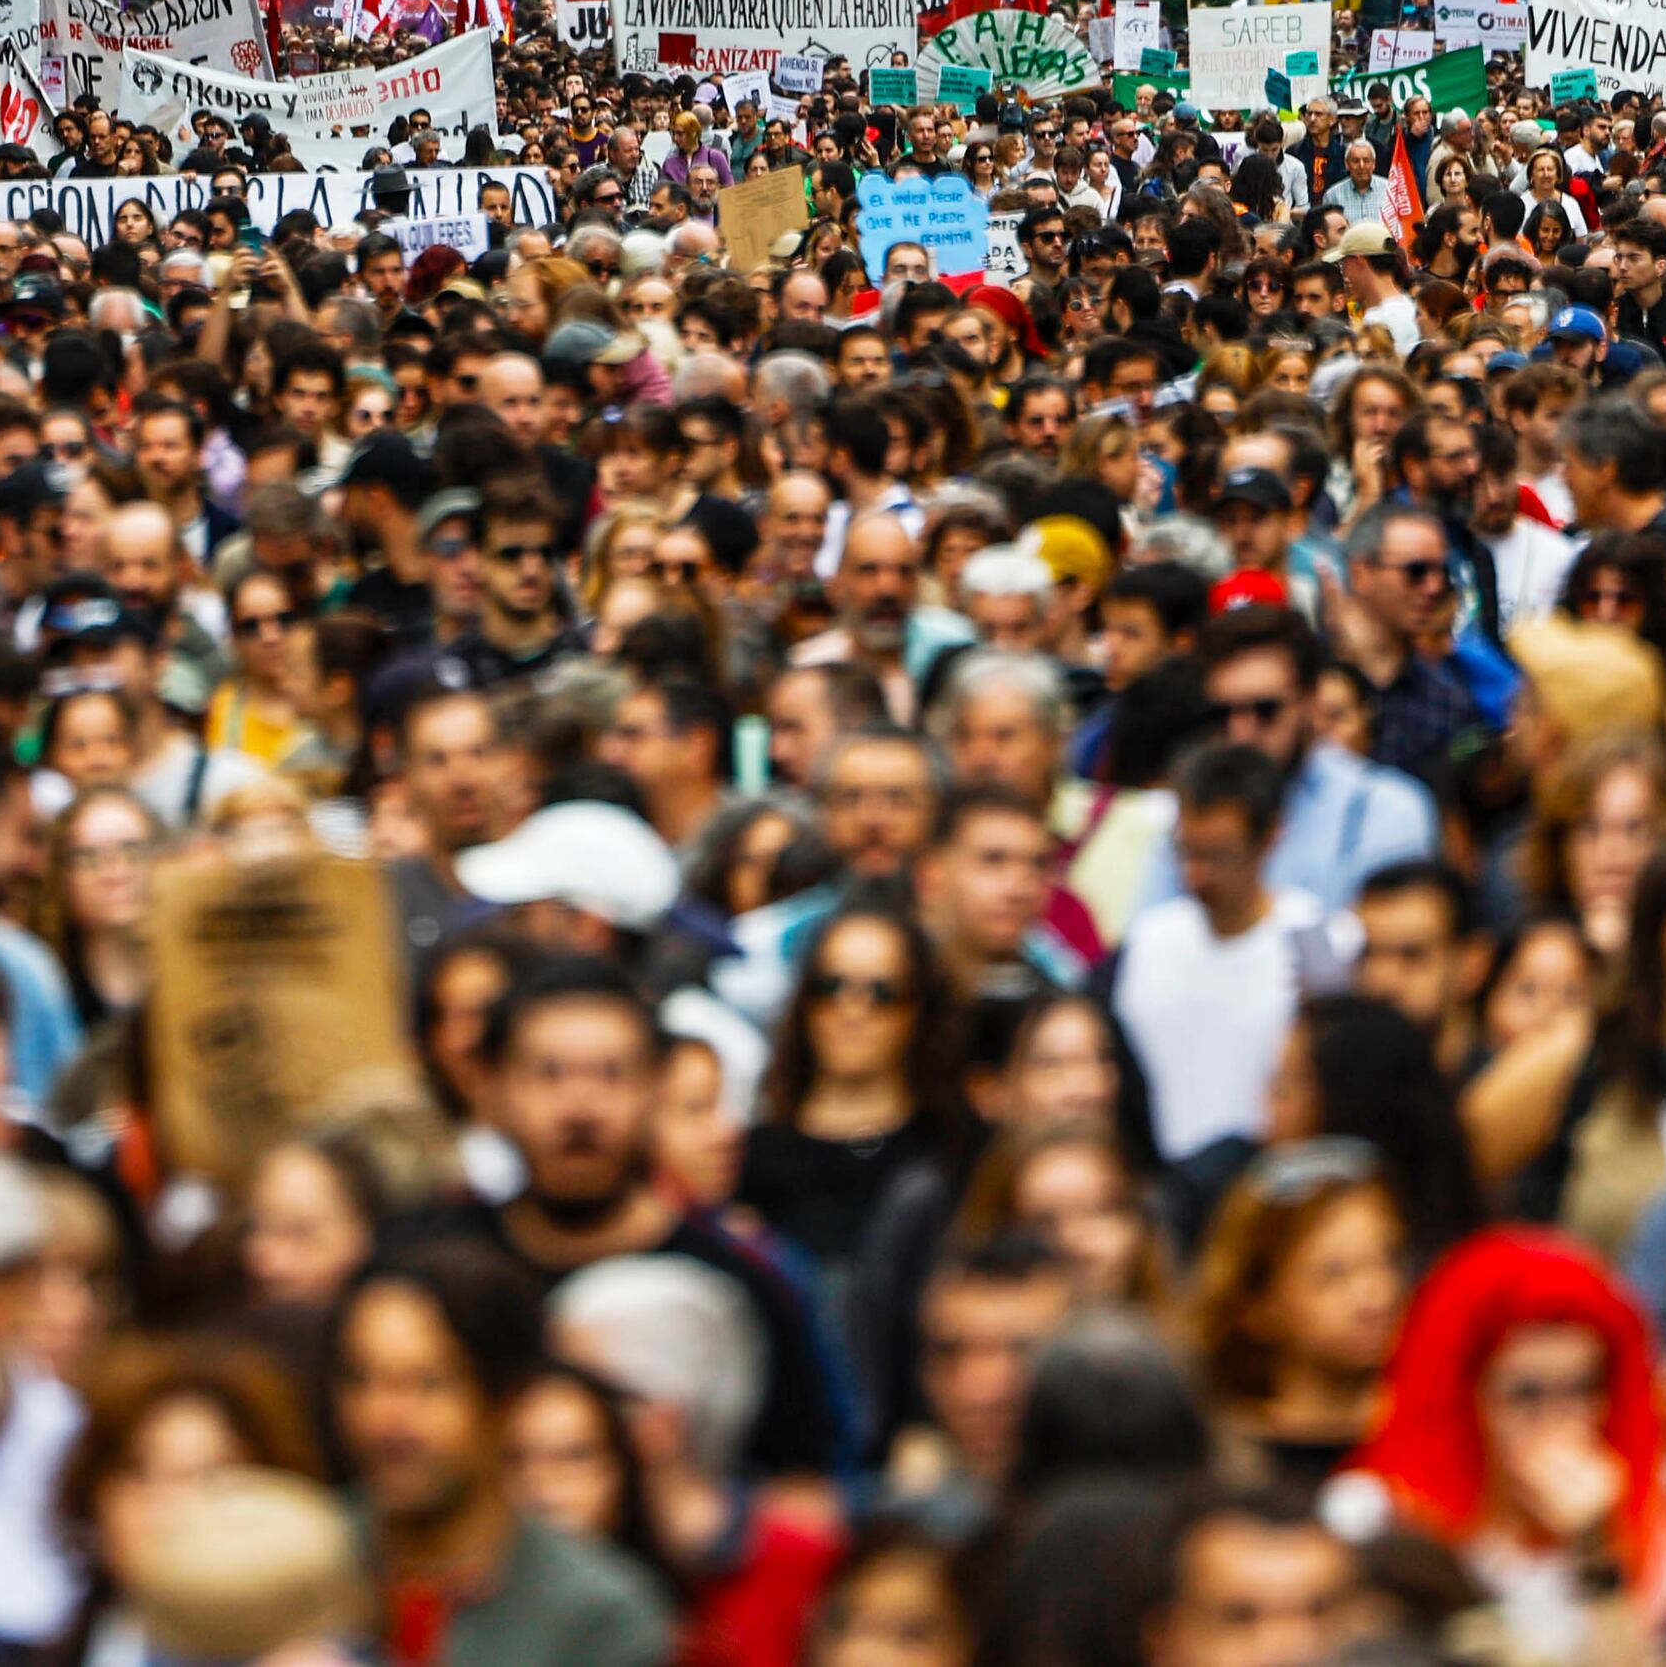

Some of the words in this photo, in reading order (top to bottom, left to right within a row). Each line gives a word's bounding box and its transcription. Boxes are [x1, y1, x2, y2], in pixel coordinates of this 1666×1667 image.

[1221, 15, 1303, 48] SAREB
[780, 55, 811, 71] VIVIENDA
[300, 76, 315, 90] LA
[302, 87, 345, 105] VIVIENDA
